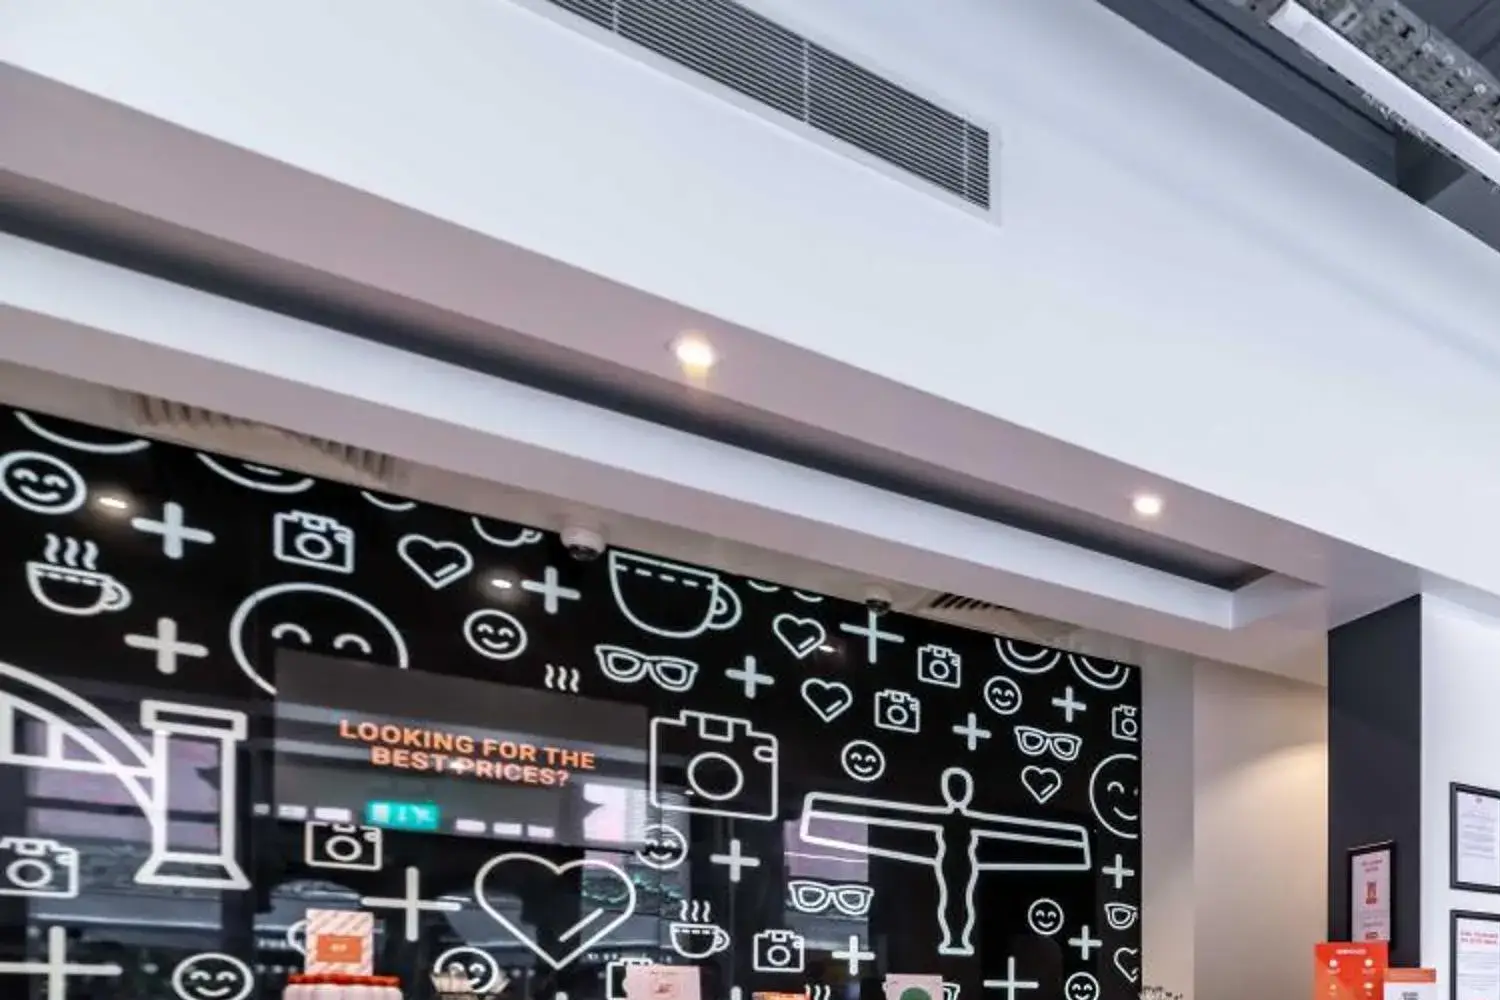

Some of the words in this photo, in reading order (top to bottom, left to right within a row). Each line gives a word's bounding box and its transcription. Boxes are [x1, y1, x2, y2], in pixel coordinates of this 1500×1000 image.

[339, 719, 475, 754] LOOKING
[482, 738, 536, 762] FOR
[543, 747, 596, 770] THE
[370, 745, 450, 773] BEST
[453, 756, 570, 787] PRICES?
